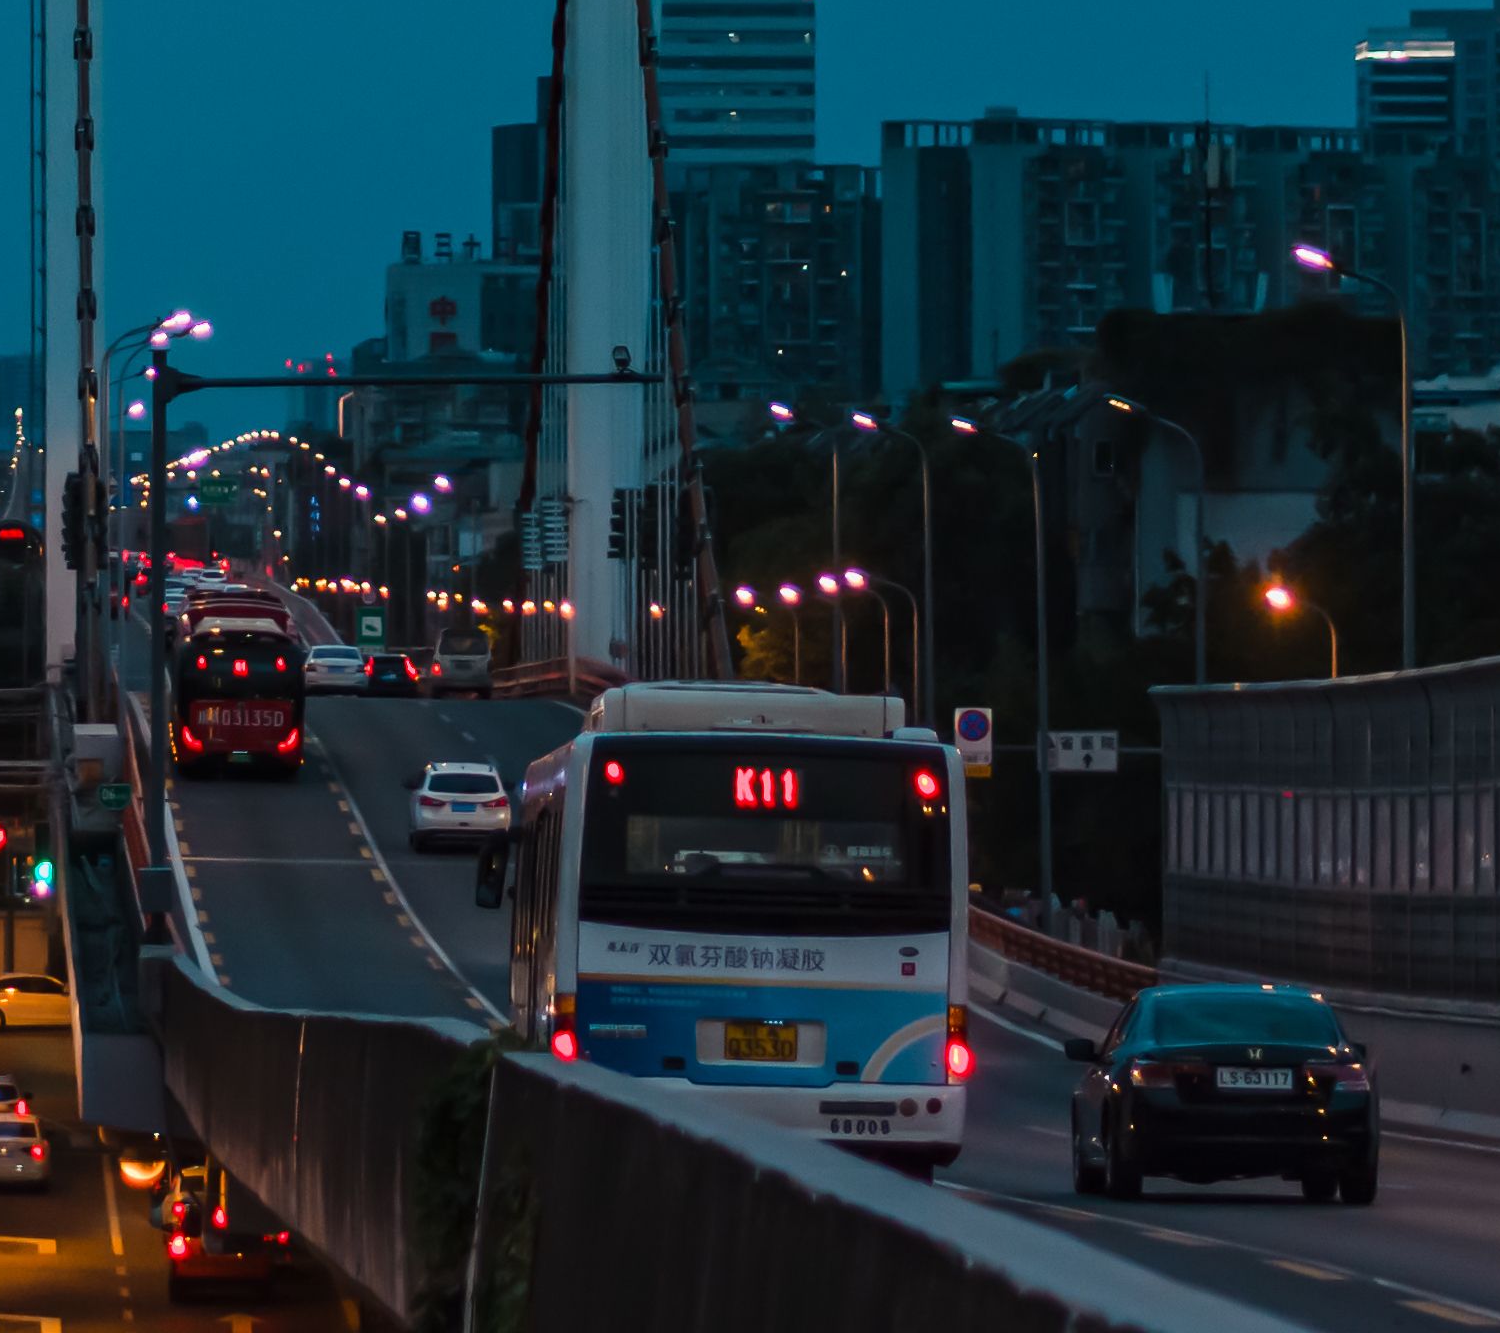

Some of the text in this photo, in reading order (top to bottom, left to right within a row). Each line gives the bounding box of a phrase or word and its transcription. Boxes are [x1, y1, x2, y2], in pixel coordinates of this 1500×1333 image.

[733, 766, 799, 811] K11
[647, 943, 825, 972] 双氯芬酸钠凝胶
